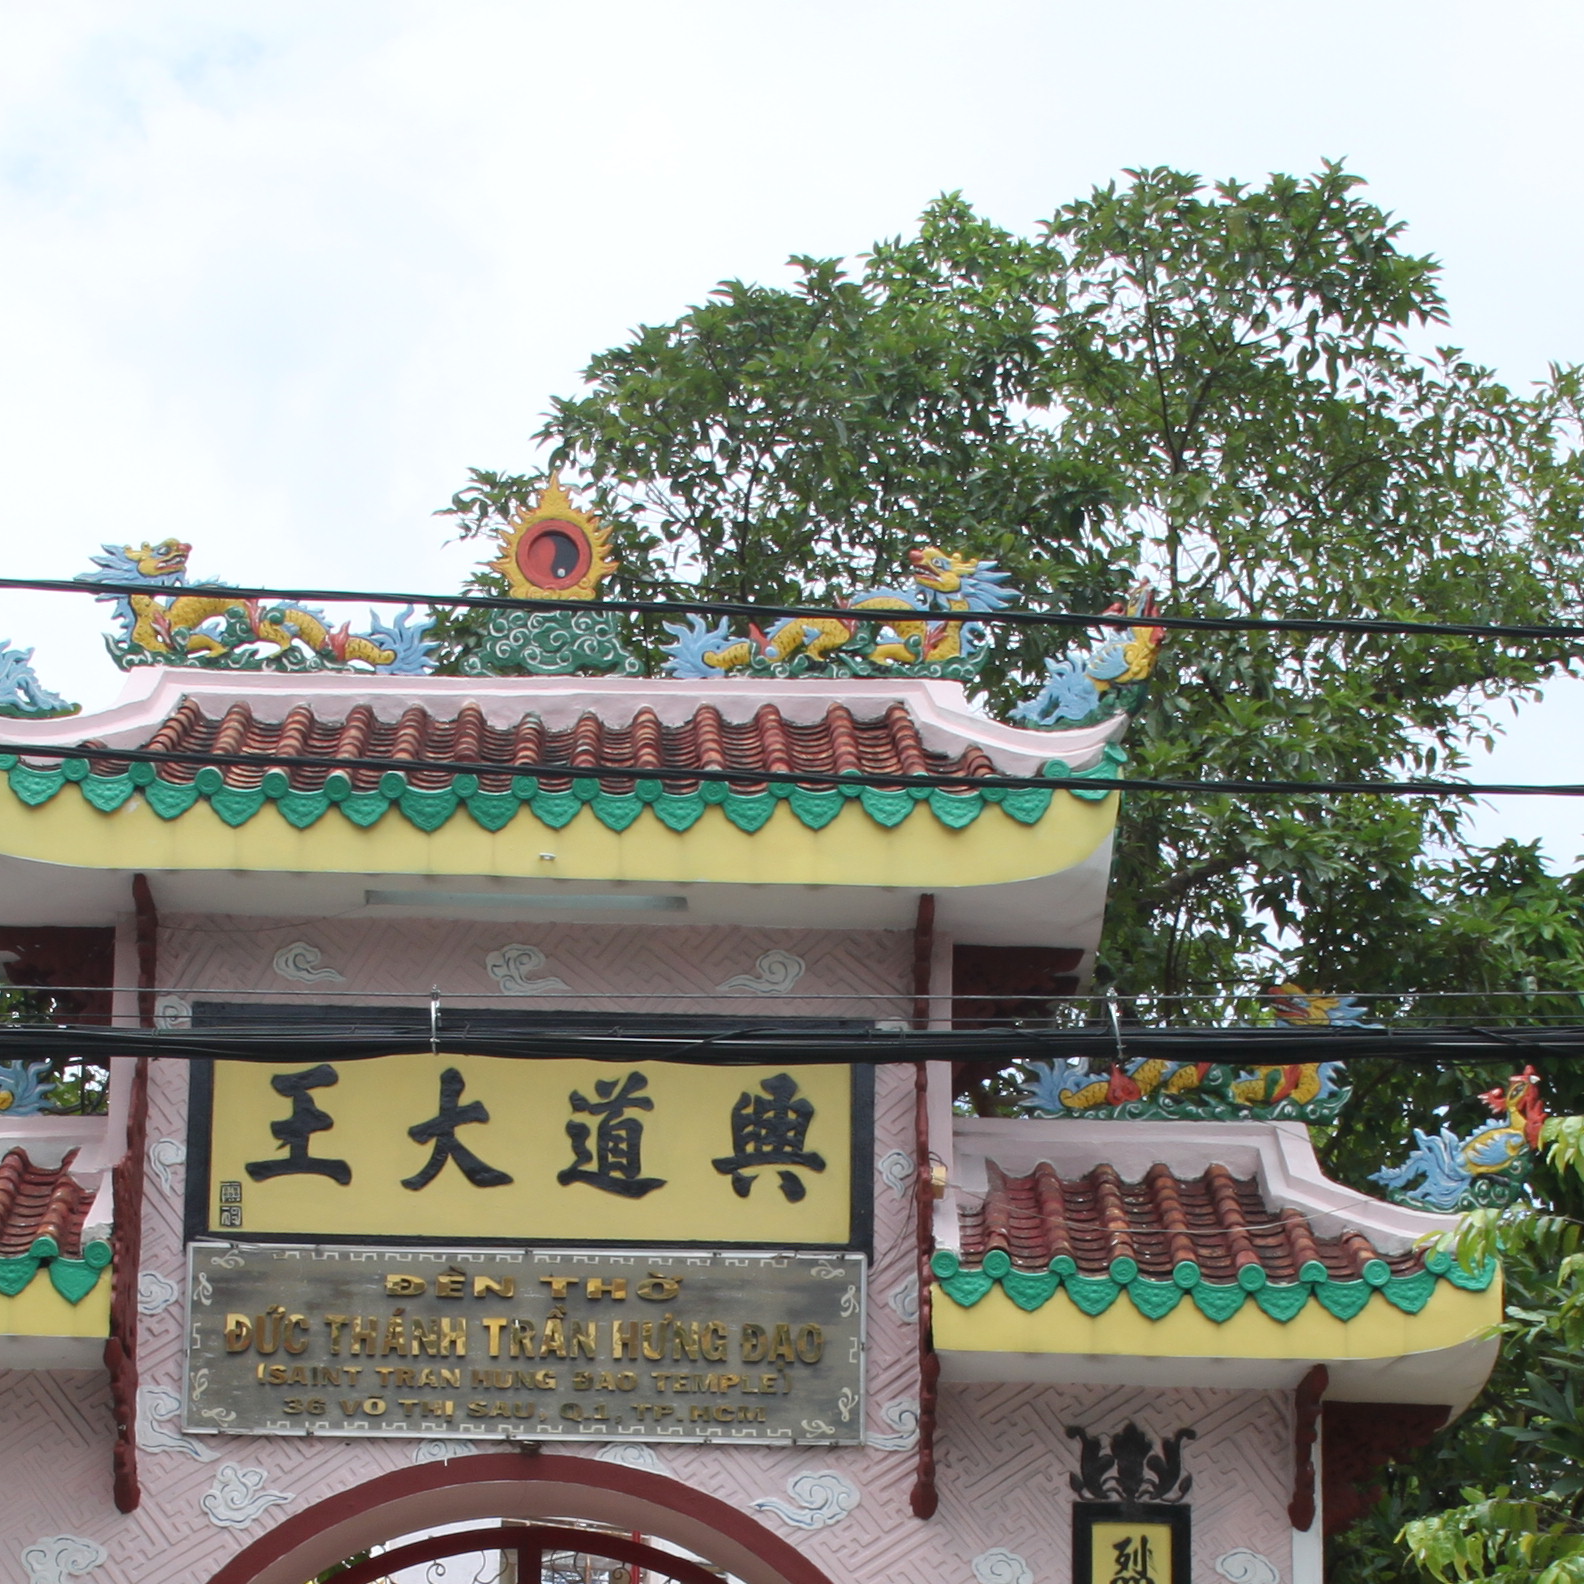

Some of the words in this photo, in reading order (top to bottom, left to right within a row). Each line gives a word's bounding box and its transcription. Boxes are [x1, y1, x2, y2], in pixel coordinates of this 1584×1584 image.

[539, 1271, 684, 1300] THỜ
[223, 1304, 310, 1354] ĐỨC
[323, 1307, 467, 1358] THÁNH
[481, 1304, 597, 1359] TRẦN
[611, 1312, 729, 1362] HƯNG
[740, 1322, 826, 1371] ĐẠO
[256, 1362, 363, 1387] (SAINT
[374, 1366, 462, 1389] TRAN
[471, 1368, 558, 1391] HUNG
[651, 1371, 794, 1395] TEMPLE)
[282, 1397, 326, 1416] 36
[397, 1399, 455, 1423] THỊ
